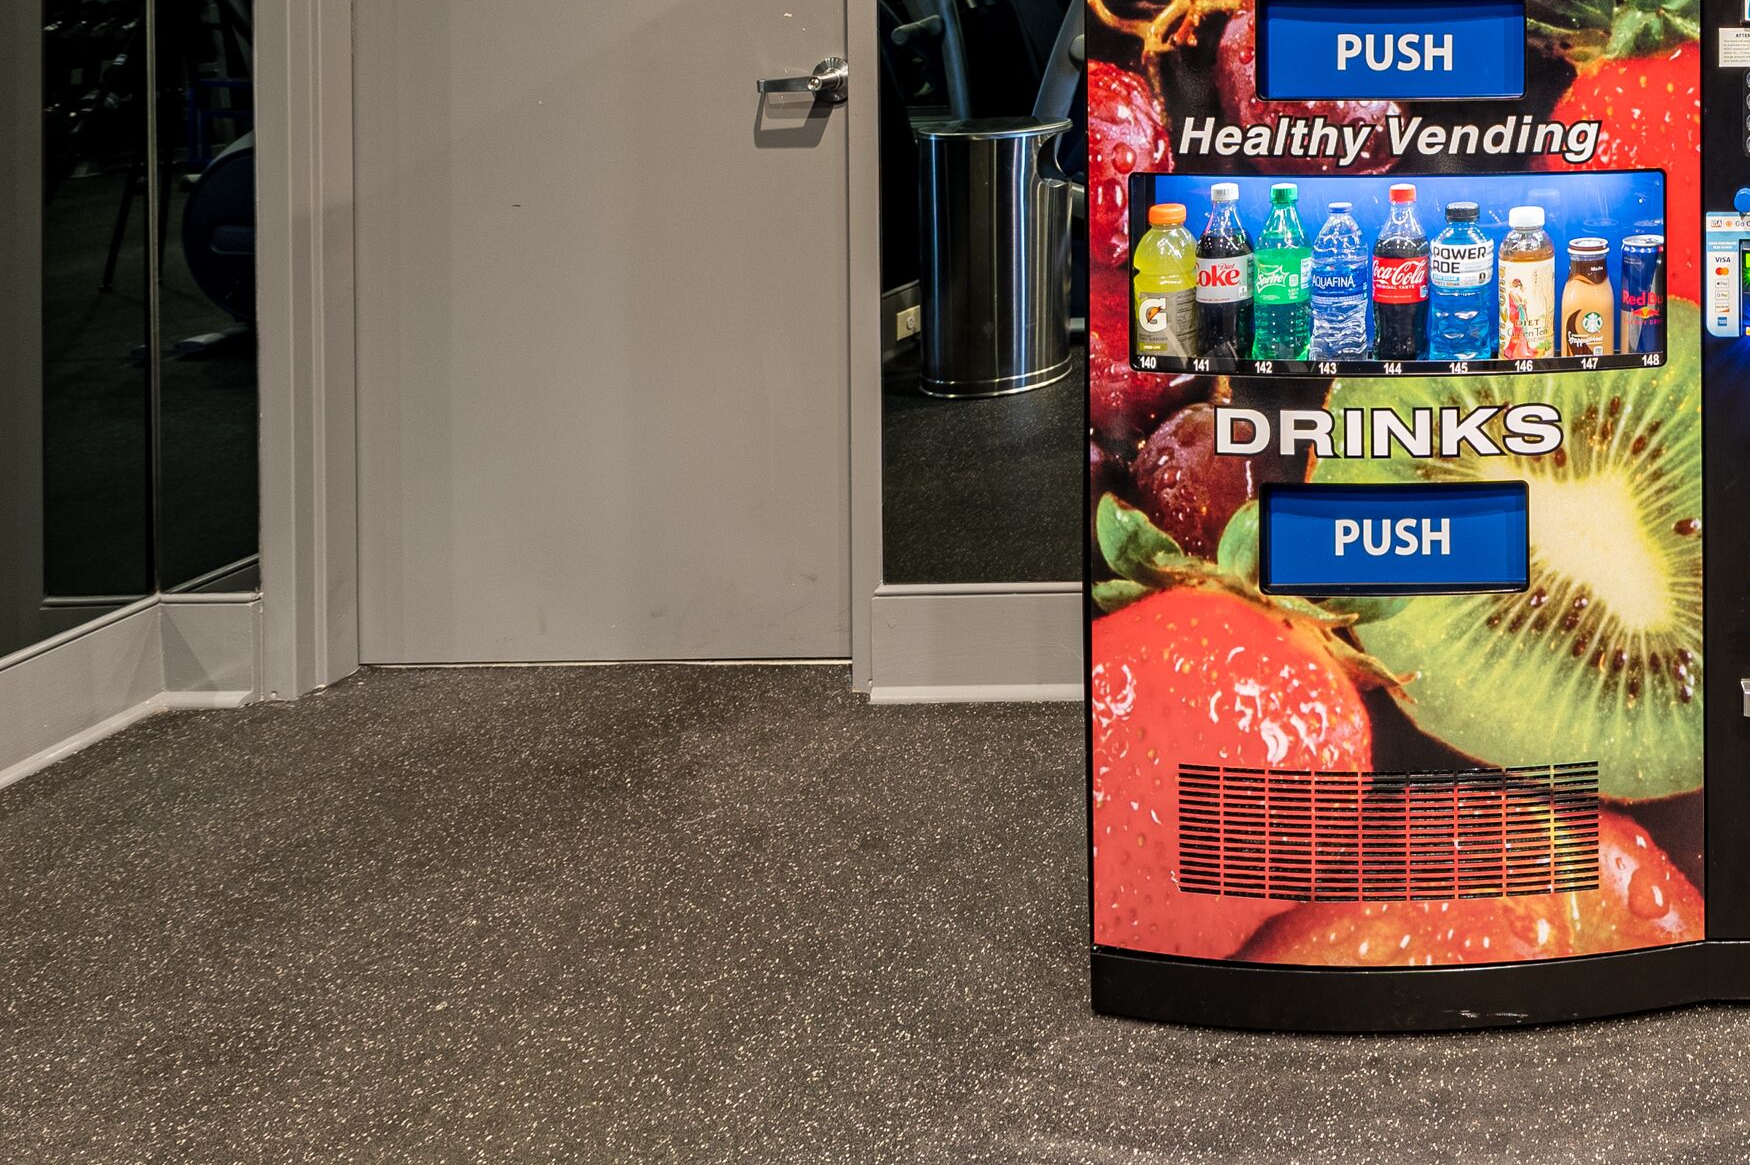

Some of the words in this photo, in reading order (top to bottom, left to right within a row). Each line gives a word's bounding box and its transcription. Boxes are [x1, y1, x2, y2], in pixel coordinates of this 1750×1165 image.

[1336, 33, 1454, 72] PUSH
[1178, 117, 1371, 167] Healthy
[1386, 116, 1600, 164] Vending
[1433, 246, 1487, 260] POWER
[1373, 259, 1427, 286] Coca-Cola
[1257, 273, 1284, 286] Sprite
[1312, 274, 1356, 290] AQUAFINA
[1621, 289, 1646, 306] Red
[1139, 297, 1167, 333] G
[1514, 319, 1540, 327] DIET
[1507, 327, 1534, 337] Green
[1535, 326, 1547, 335] Tea
[1140, 356, 1157, 369] 140
[1193, 359, 1210, 371] 141
[1515, 360, 1533, 372] 146
[1581, 357, 1599, 369] 147
[1642, 353, 1660, 366] 148
[1255, 361, 1273, 373] 142
[1318, 362, 1337, 374] 143
[1383, 362, 1402, 374] 144
[1449, 362, 1468, 374] 145
[1214, 404, 1563, 458] DRINKS
[1335, 517, 1450, 556] PUSH
